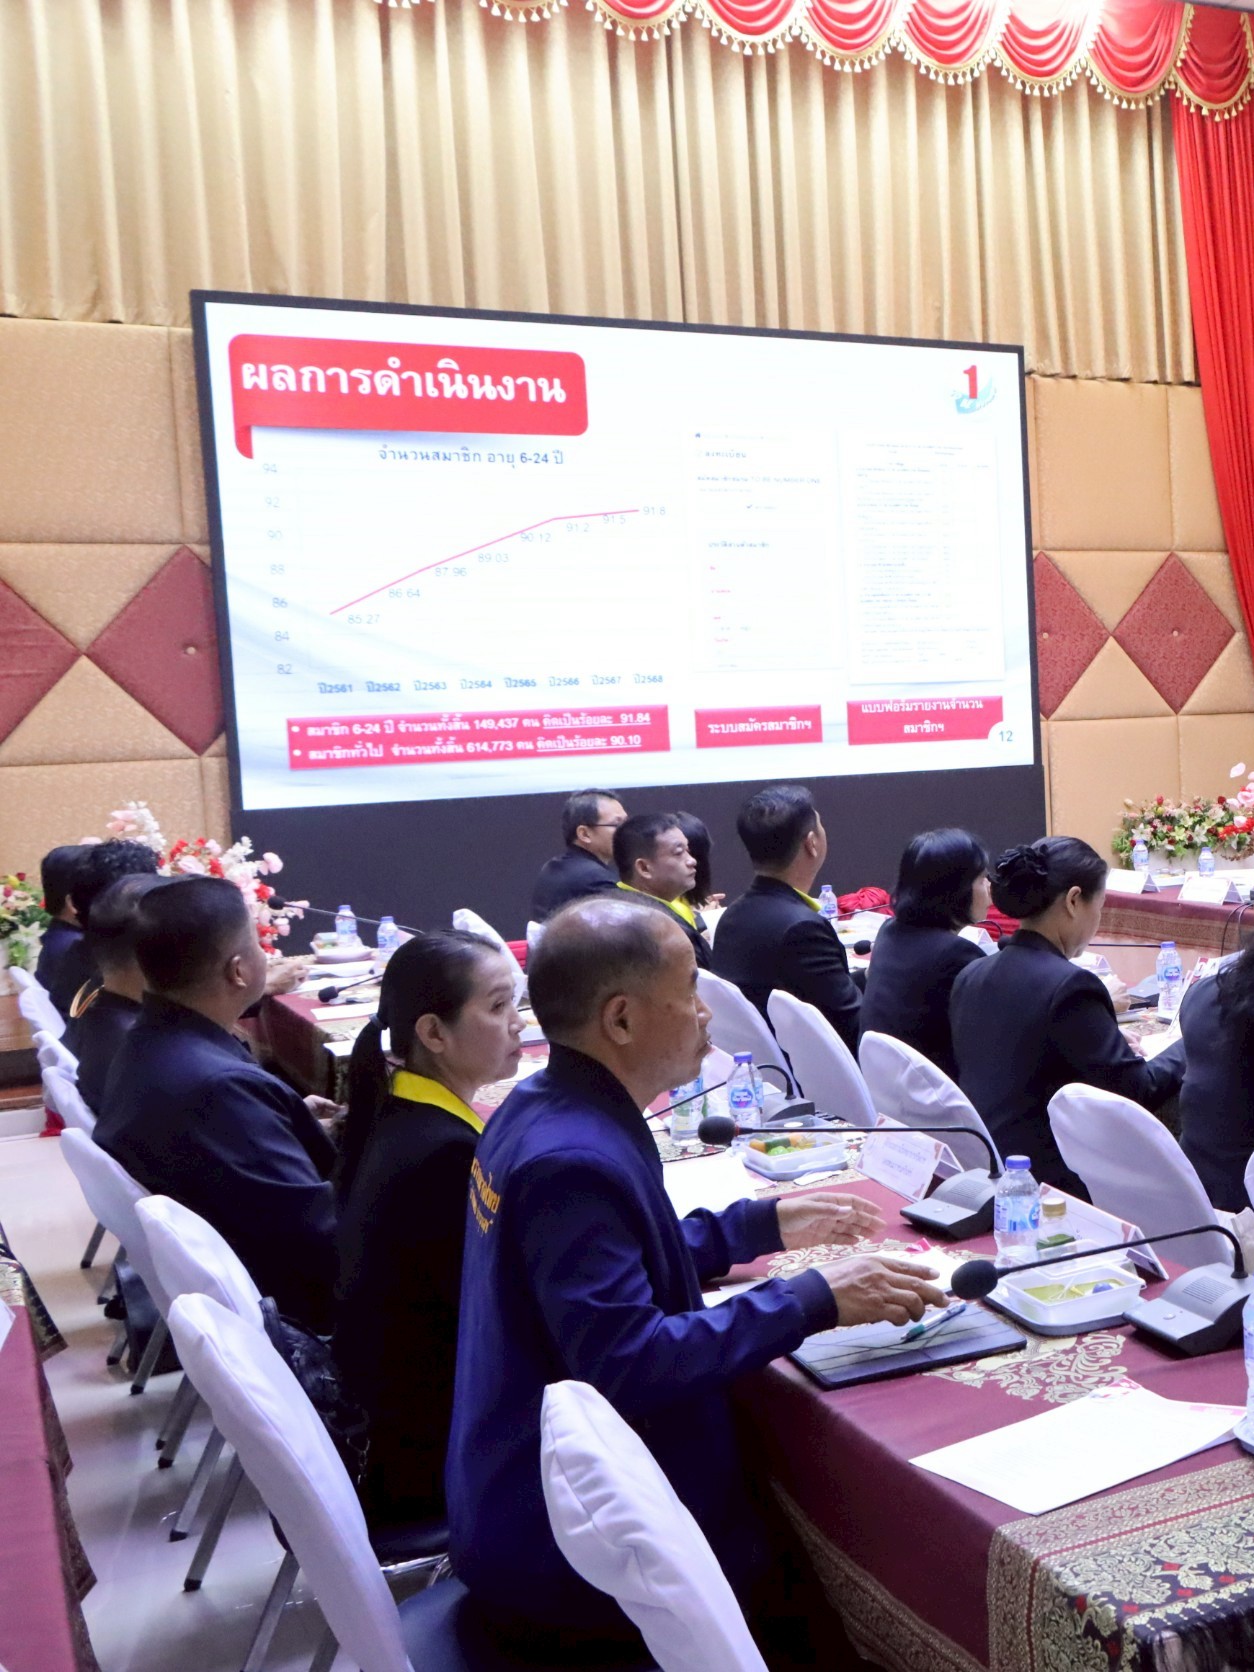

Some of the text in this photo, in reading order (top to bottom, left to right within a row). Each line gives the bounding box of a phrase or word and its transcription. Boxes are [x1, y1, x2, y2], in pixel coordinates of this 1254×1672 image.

[240, 356, 567, 404] ผลการดำเนินงาน
[963, 364, 978, 399] 1
[378, 443, 564, 469] จำนวนสมาชิก อายุ 6-24 ปี
[306, 722, 350, 737] สมาชิก
[352, 724, 381, 736] 6-24
[384, 719, 395, 734] ปี
[473, 717, 519, 730] 149,437
[620, 712, 651, 724] 91.84
[707, 718, 812, 735] ระบบสมัครสมาชิกฯ
[903, 720, 945, 735] สมาชิกฯ
[467, 741, 513, 753] 614,773
[610, 734, 641, 747] 90.10
[998, 730, 1014, 742] 12
